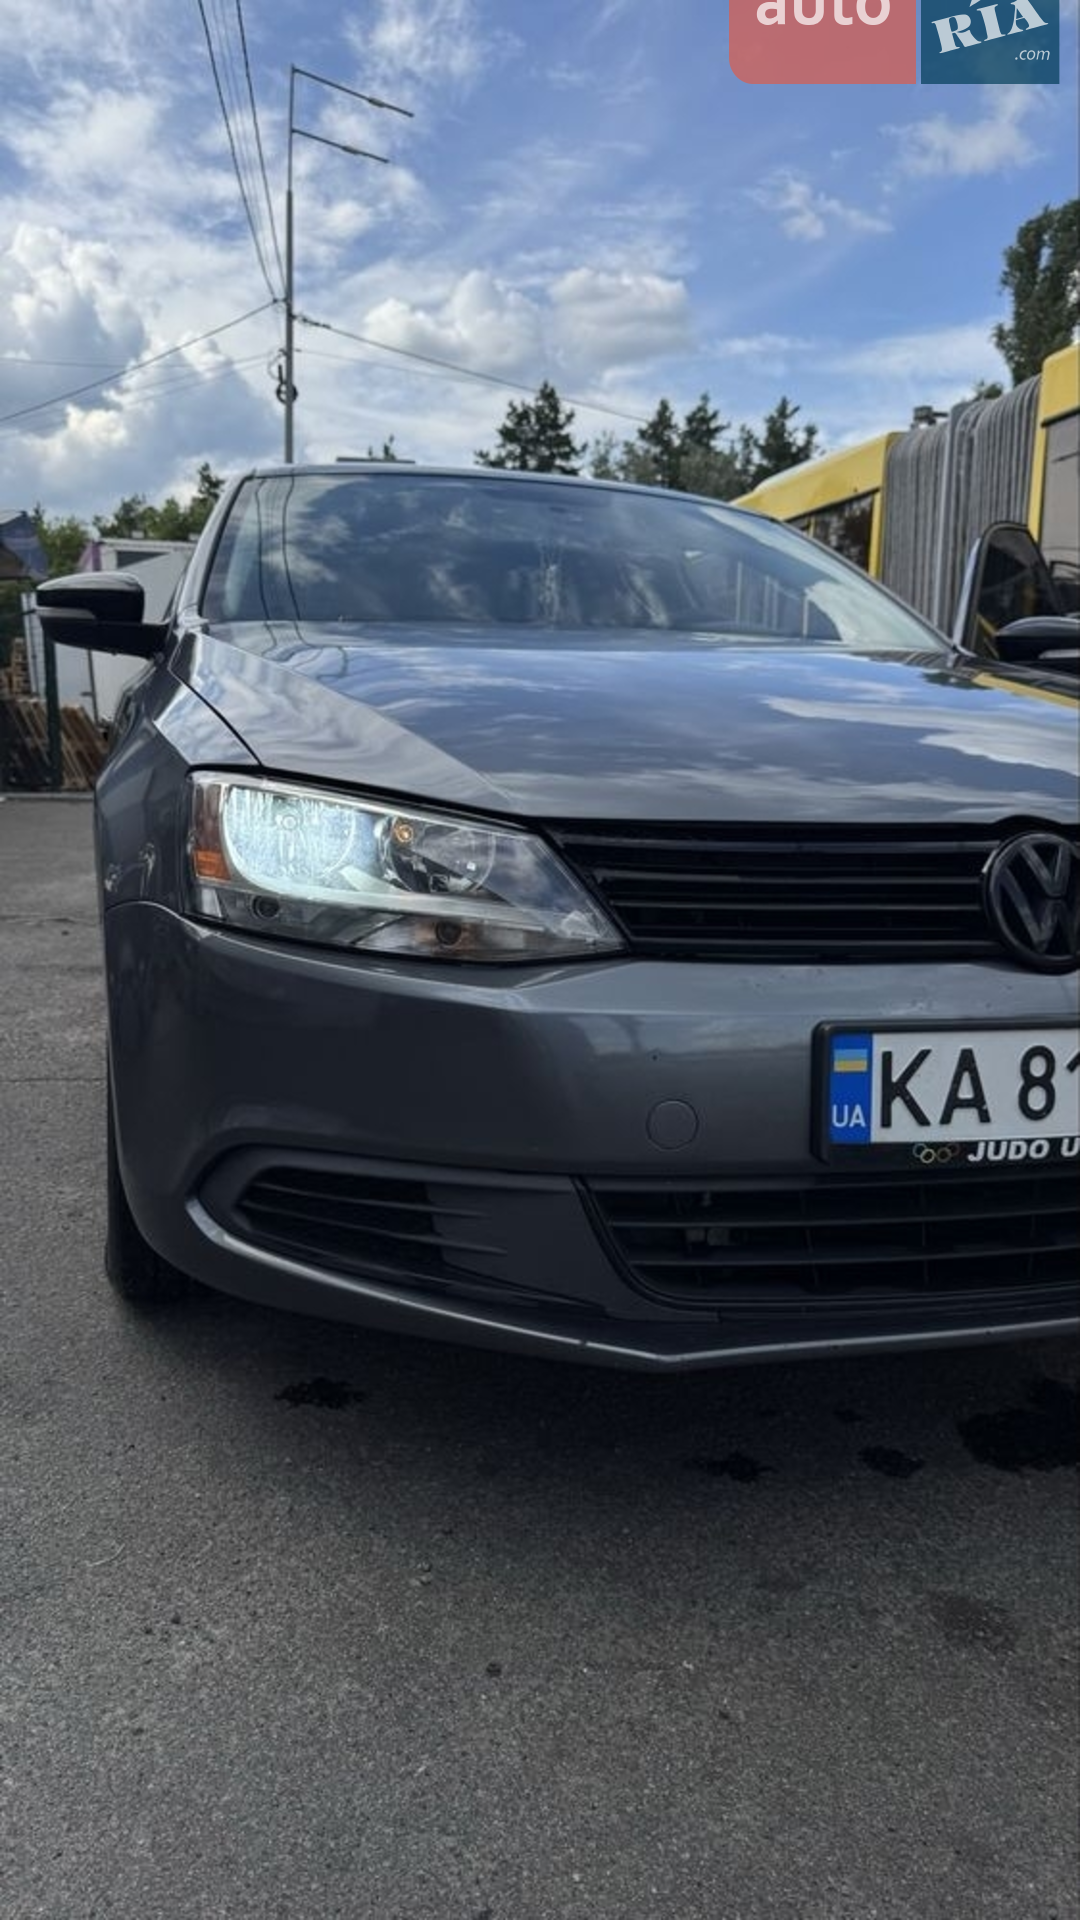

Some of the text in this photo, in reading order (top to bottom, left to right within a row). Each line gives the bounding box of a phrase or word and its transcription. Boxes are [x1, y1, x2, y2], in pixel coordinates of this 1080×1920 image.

[880, 1045, 1080, 1128] KA 8
[831, 1104, 867, 1128] UA
[967, 1139, 1050, 1162] JUDO
